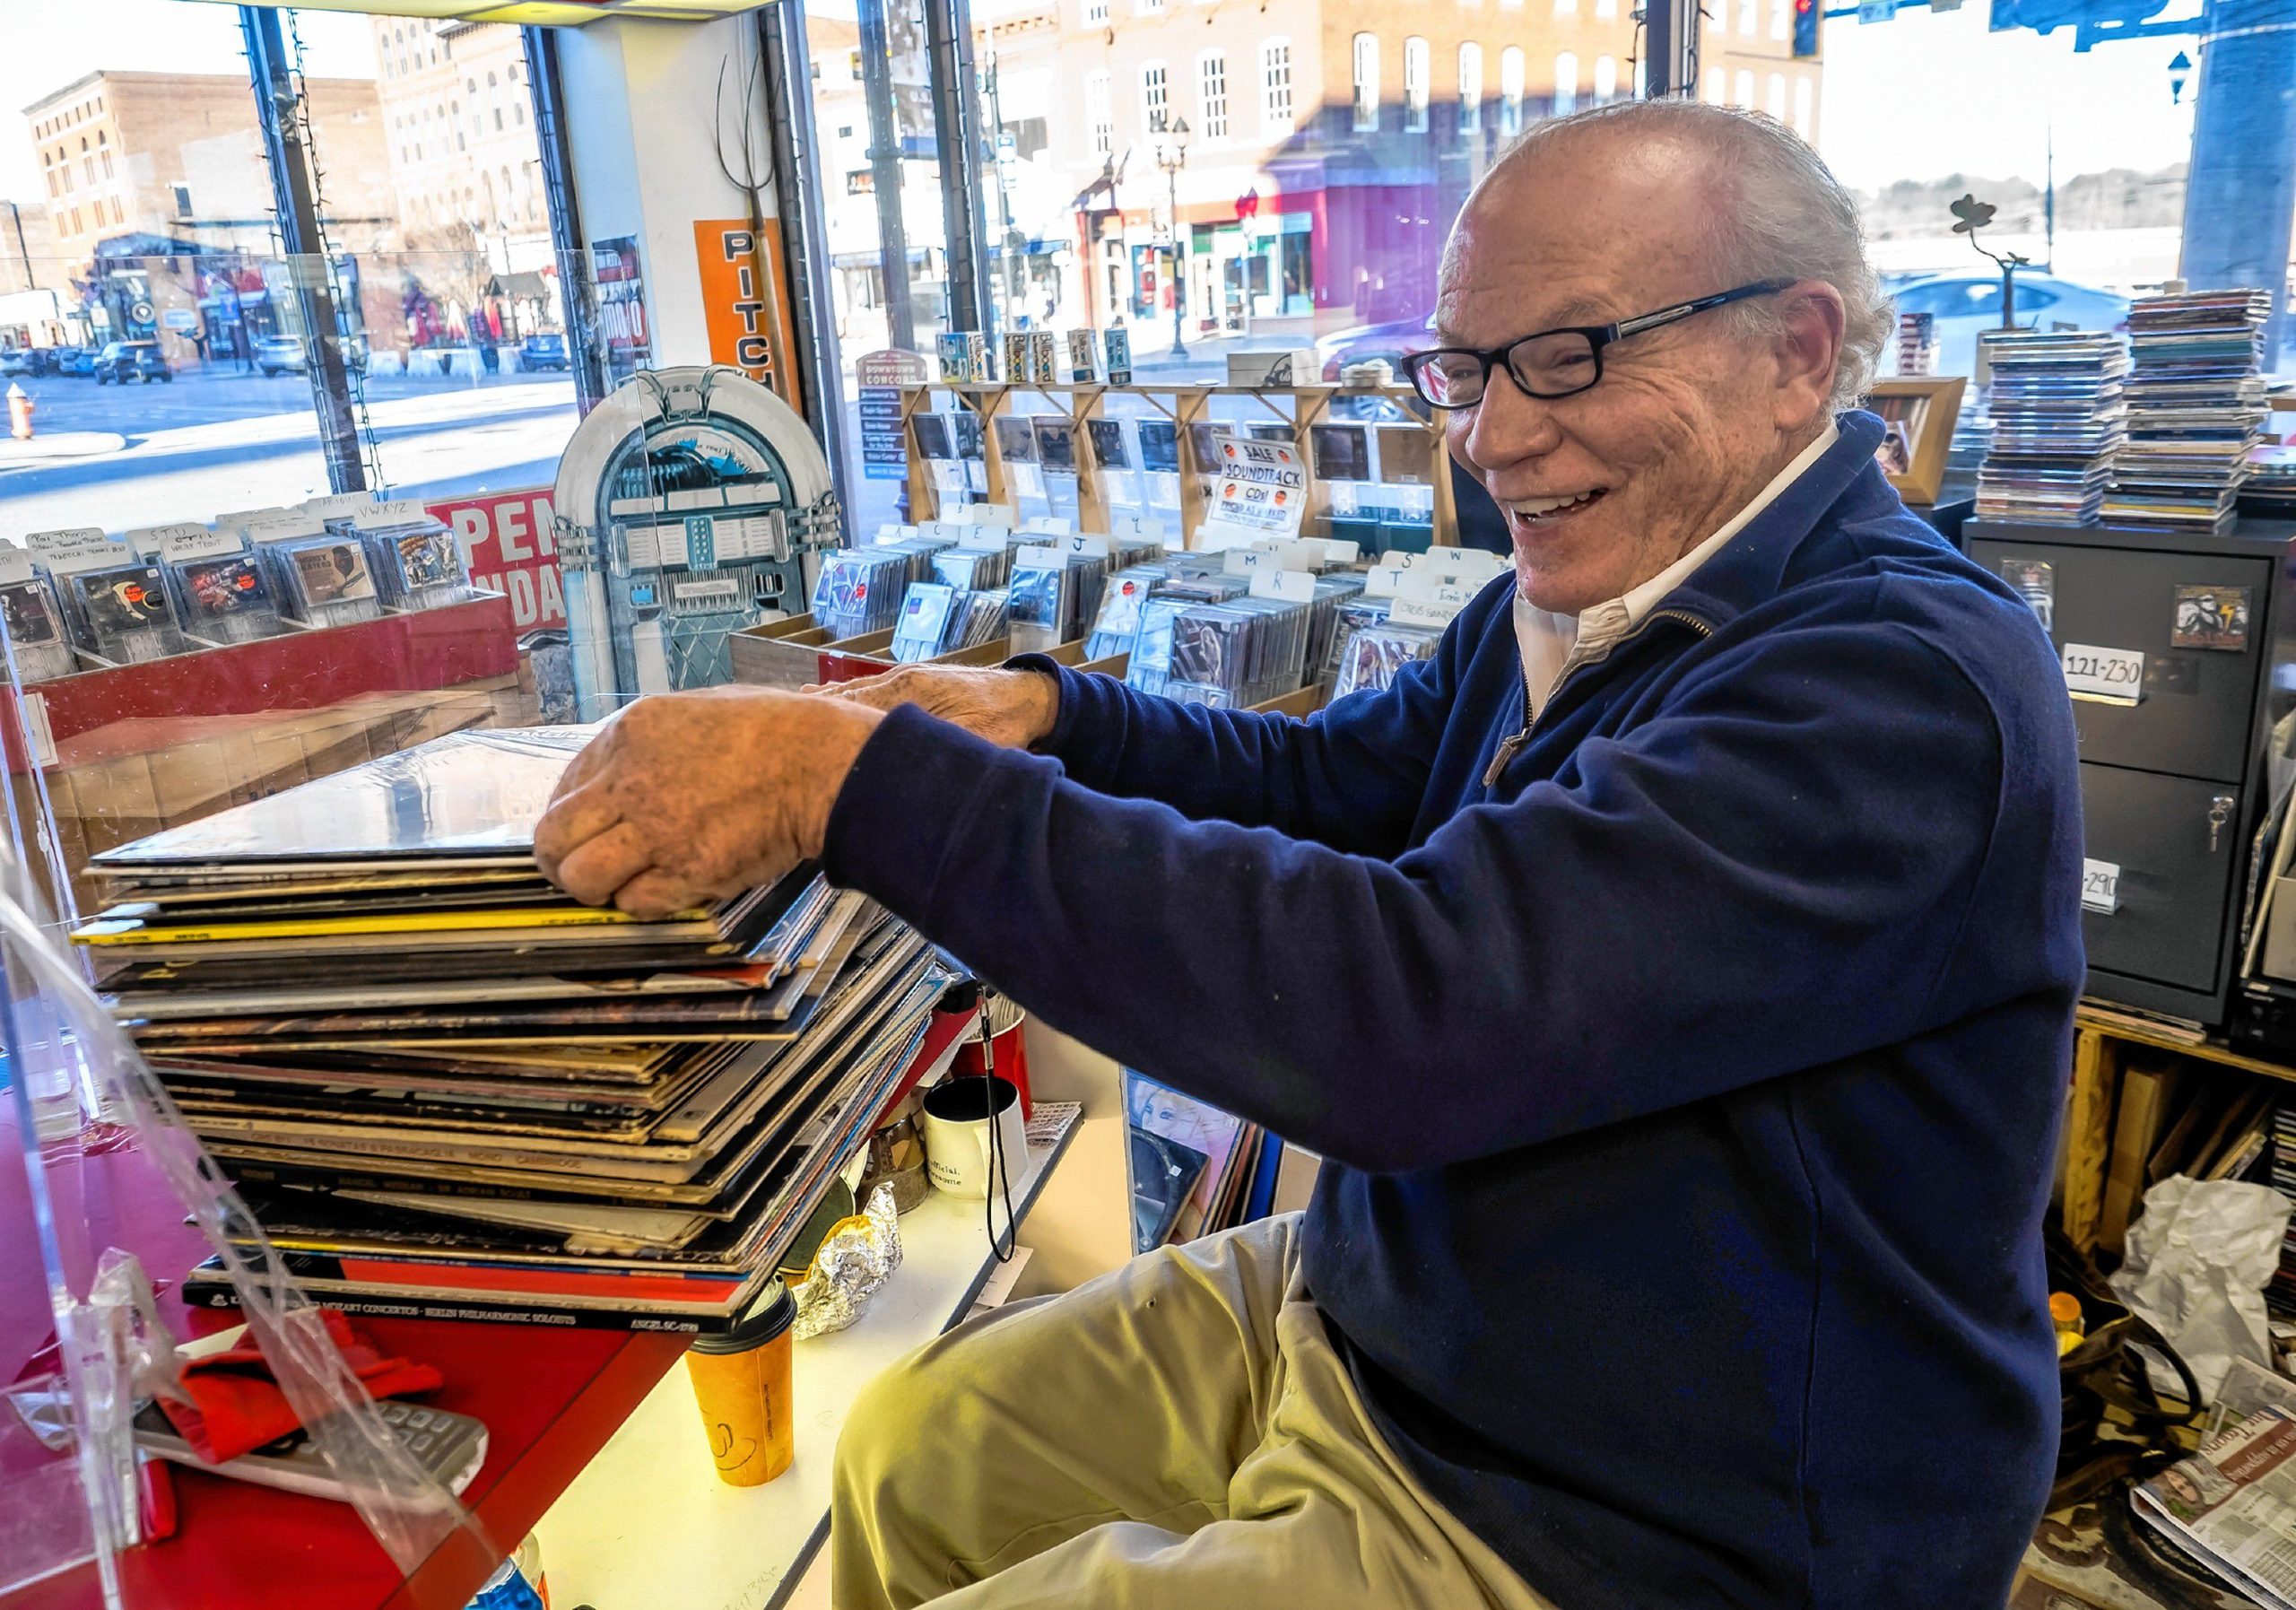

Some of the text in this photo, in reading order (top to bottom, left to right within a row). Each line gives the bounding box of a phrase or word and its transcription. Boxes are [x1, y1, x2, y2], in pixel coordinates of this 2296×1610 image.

[974, 335, 985, 381] Billboard
[1013, 335, 1027, 382] Billboard
[1040, 335, 1053, 382] Billboard
[865, 365, 916, 374] DOWNTOWN
[865, 375, 918, 385] CONCORD
[1244, 446, 1274, 460] SALE
[1226, 464, 1300, 485] SOUNDTRACK
[974, 526, 984, 538] E
[1072, 537, 1087, 552] J
[1245, 555, 1257, 566] M
[1402, 553, 1414, 569] S
[1450, 551, 1462, 561] W
[1274, 570, 1283, 590] R
[1390, 570, 1403, 587] T
[2066, 655, 2141, 684] 121-230
[317, 1139, 365, 1151] SONATAS
[322, 1301, 361, 1312] MOZART
[362, 1303, 418, 1316] CONCERTOS
[425, 1307, 457, 1318] BERLIN
[458, 1310, 532, 1323] PHILHARMONIC
[533, 1313, 577, 1325] SOLOISTS
